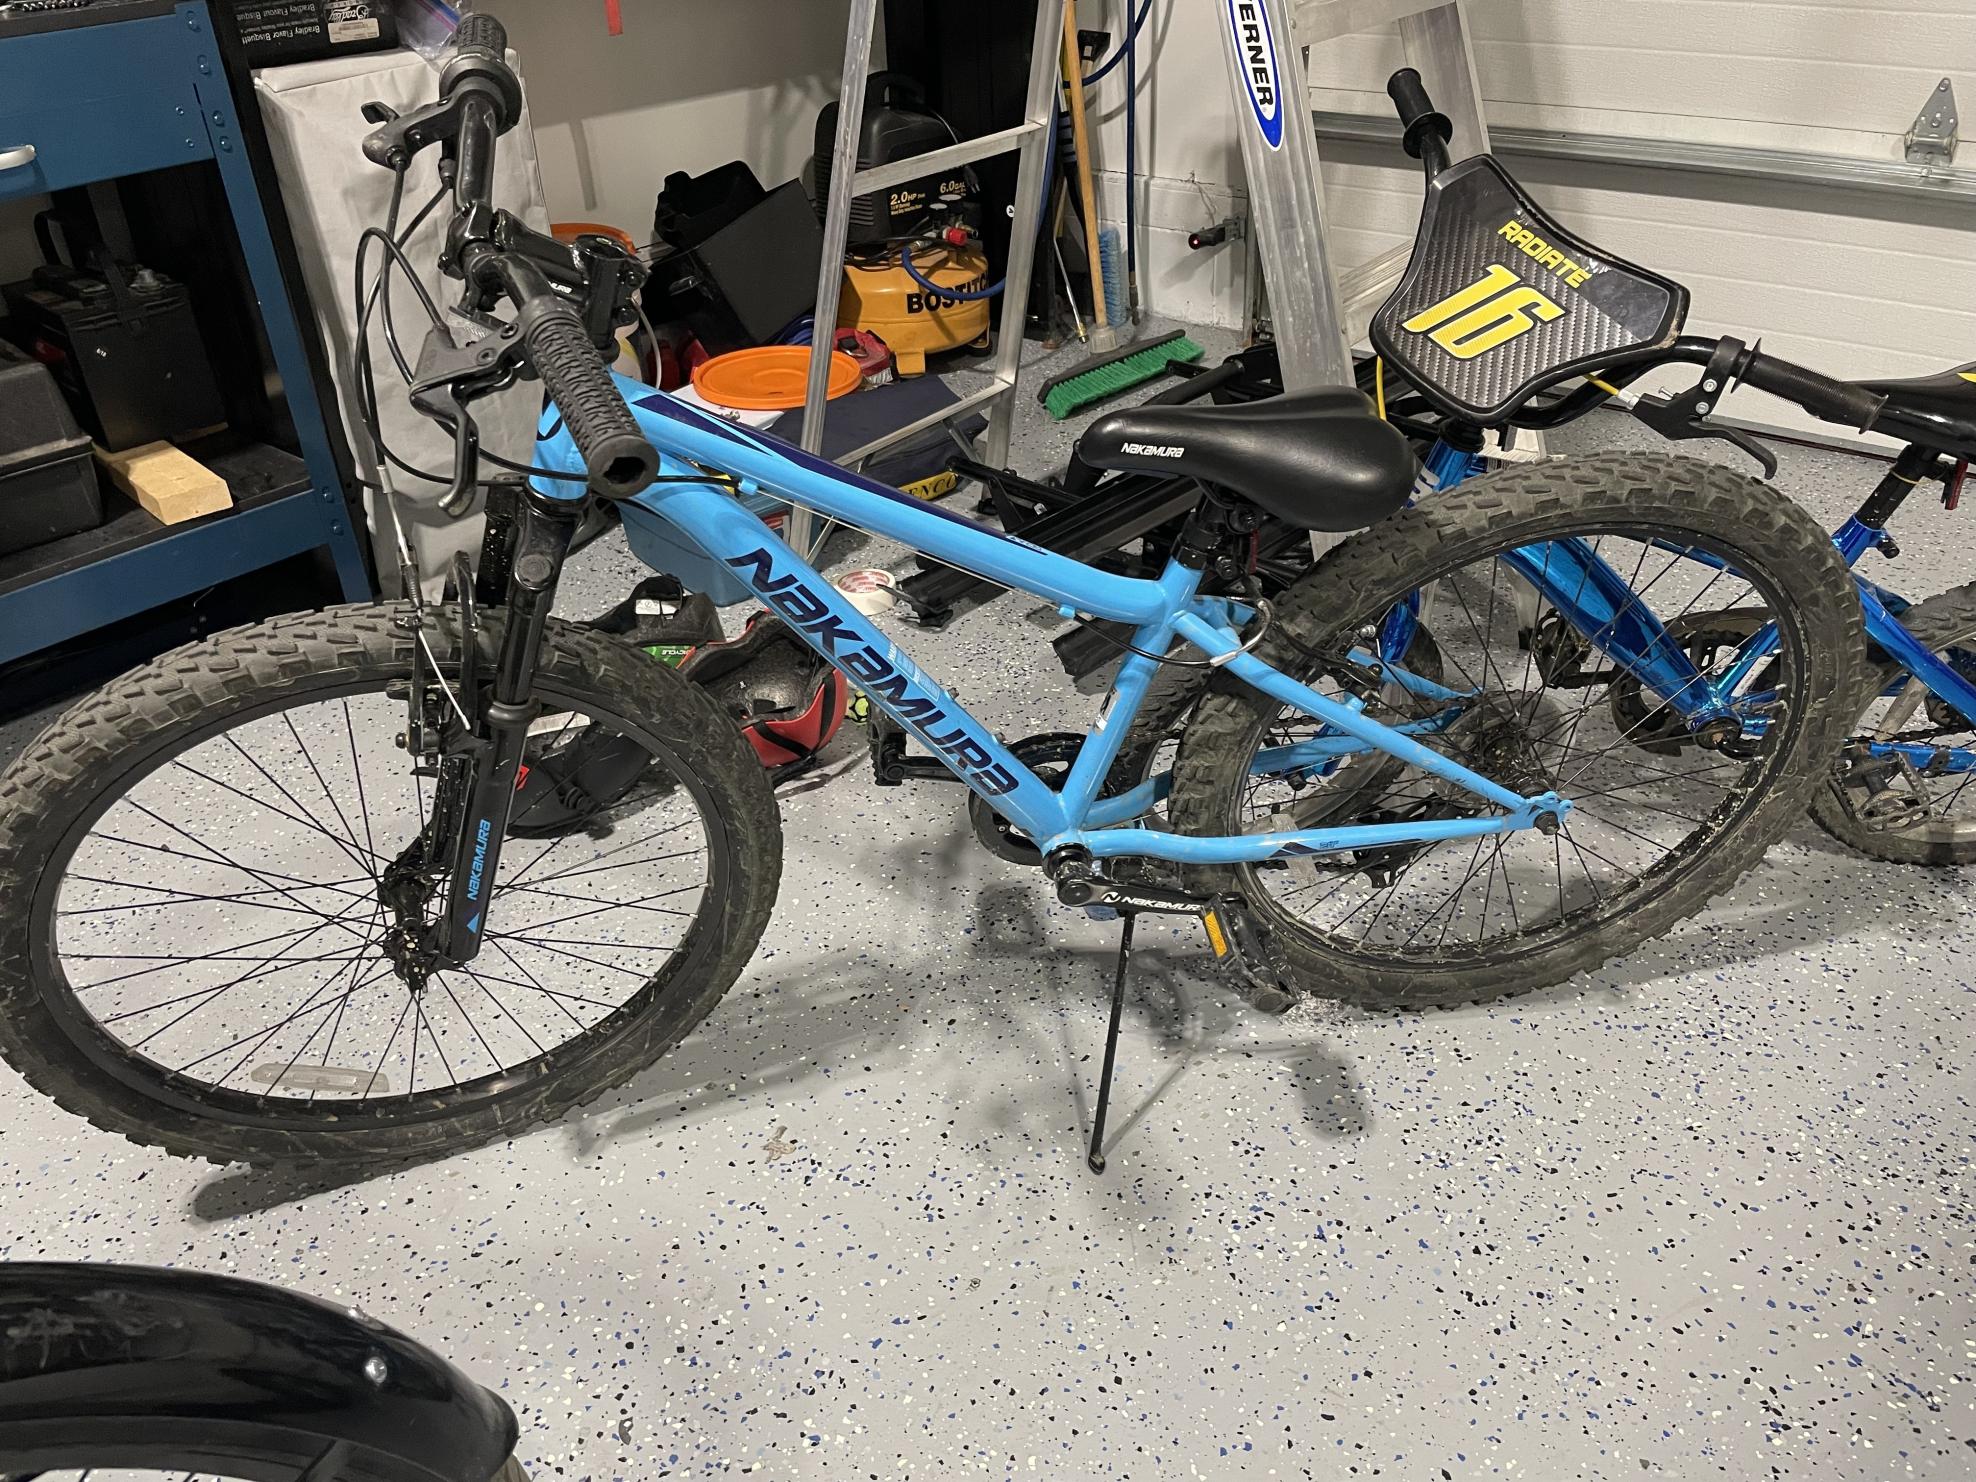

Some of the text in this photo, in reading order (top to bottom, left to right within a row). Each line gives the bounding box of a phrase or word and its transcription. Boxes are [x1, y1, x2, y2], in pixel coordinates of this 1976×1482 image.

[272, 30, 294, 38] Flavor
[295, 25, 320, 35] Bradley
[1239, 0, 1274, 106] ERNER
[1497, 219, 1593, 289] RADIATE
[1400, 263, 1568, 360] 16
